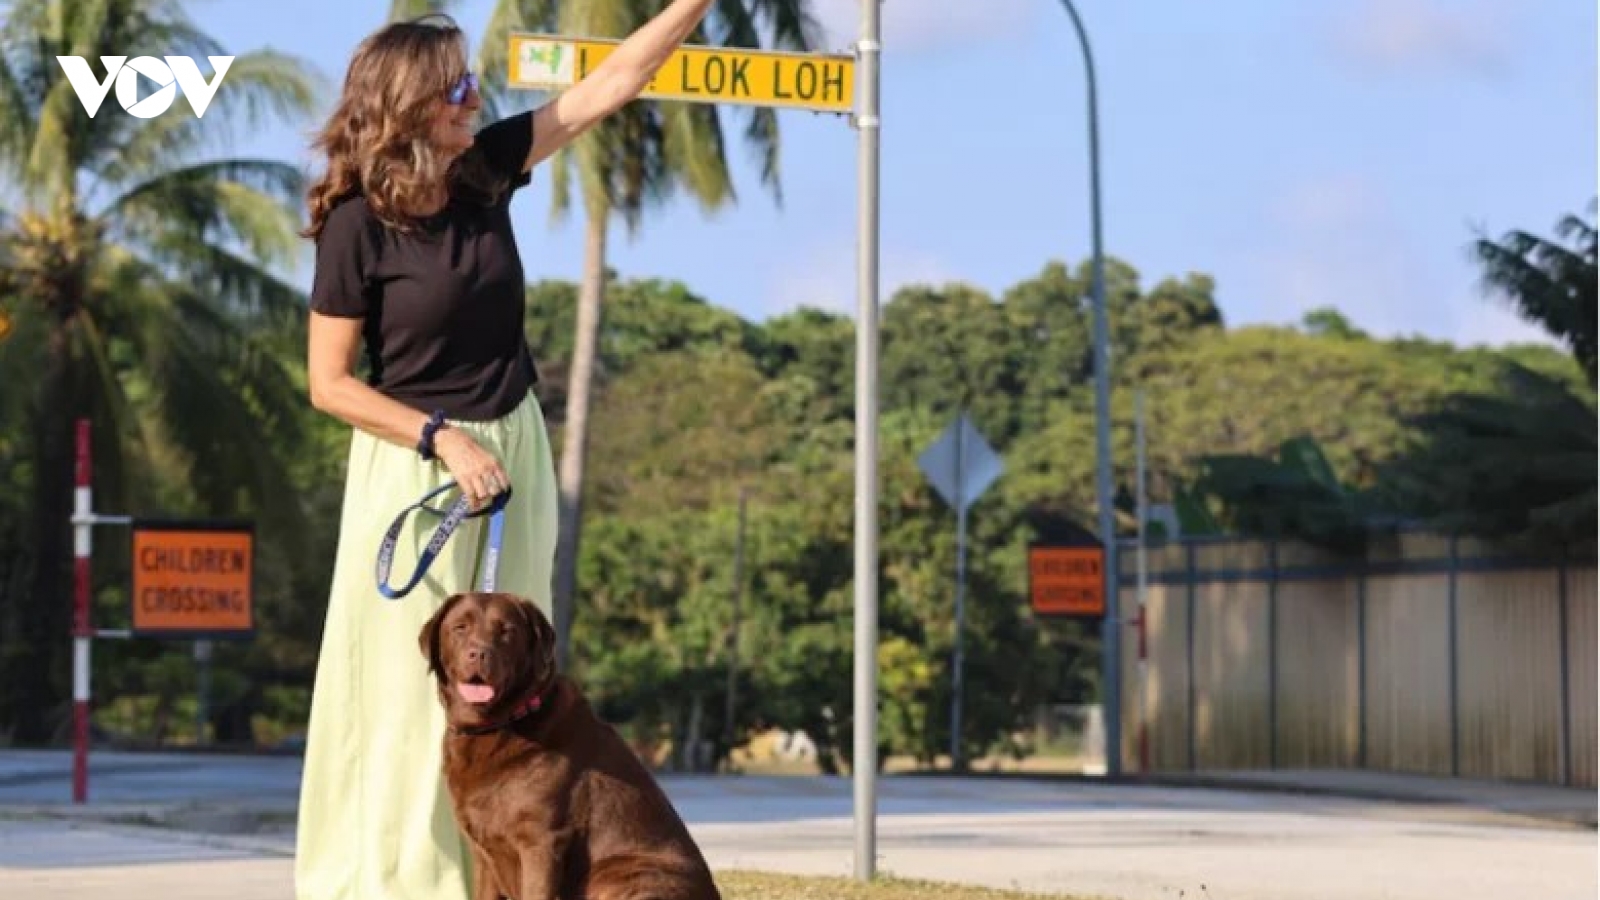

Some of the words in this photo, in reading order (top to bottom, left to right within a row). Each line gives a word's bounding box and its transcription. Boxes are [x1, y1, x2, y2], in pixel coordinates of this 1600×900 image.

[681, 54, 750, 96] LOK
[773, 60, 845, 102] LOH
[140, 546, 244, 574] CHILDREN
[142, 585, 244, 614] CROSSING
